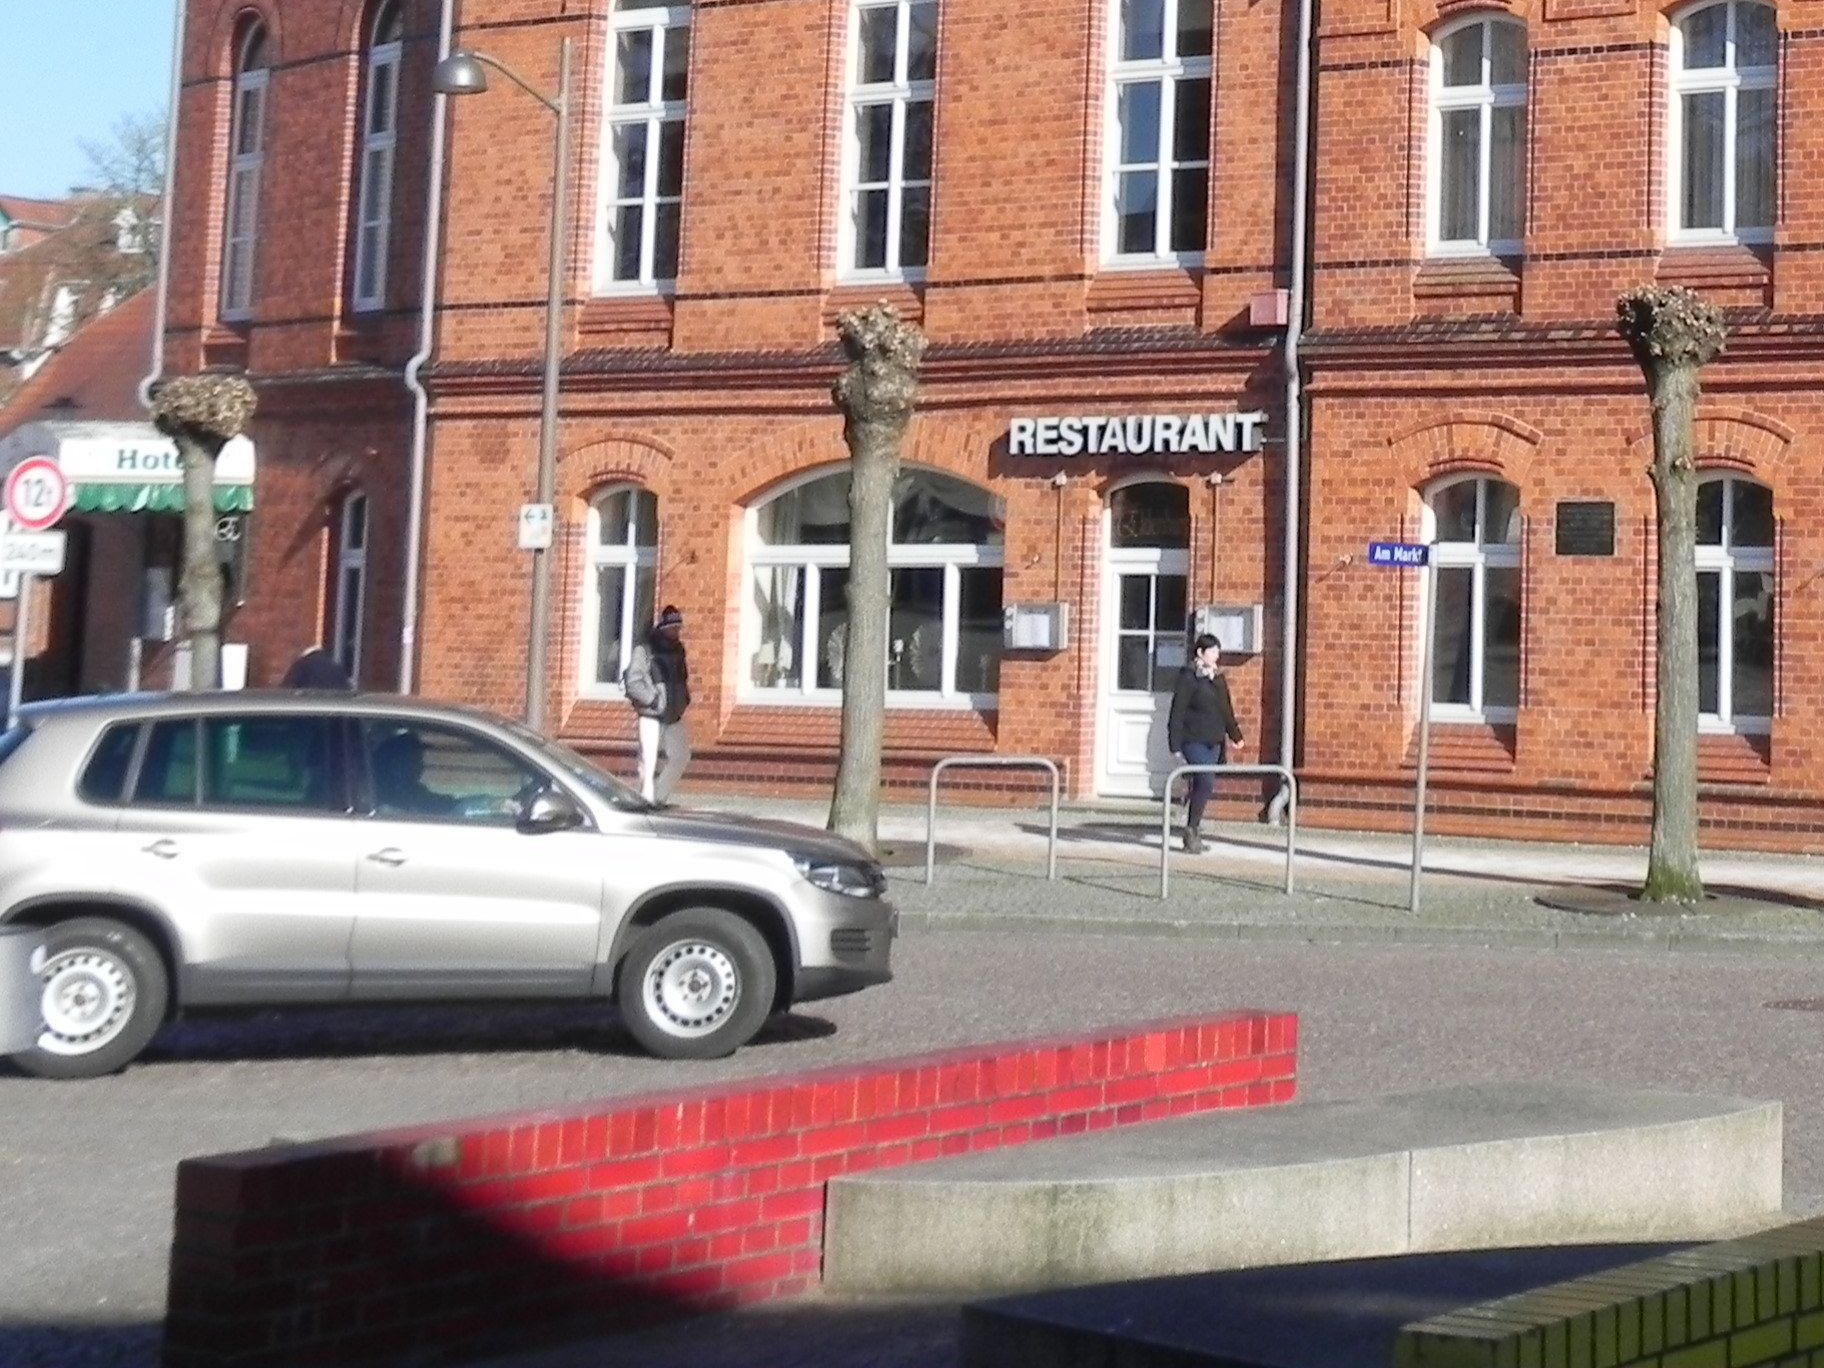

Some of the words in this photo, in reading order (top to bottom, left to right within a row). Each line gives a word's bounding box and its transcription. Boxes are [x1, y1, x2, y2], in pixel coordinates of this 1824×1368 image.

[1008, 412, 1264, 456] RESTAURANT
[117, 448, 187, 471] Hote
[1374, 545, 1392, 562] Am
[1394, 545, 1422, 563] Markt
